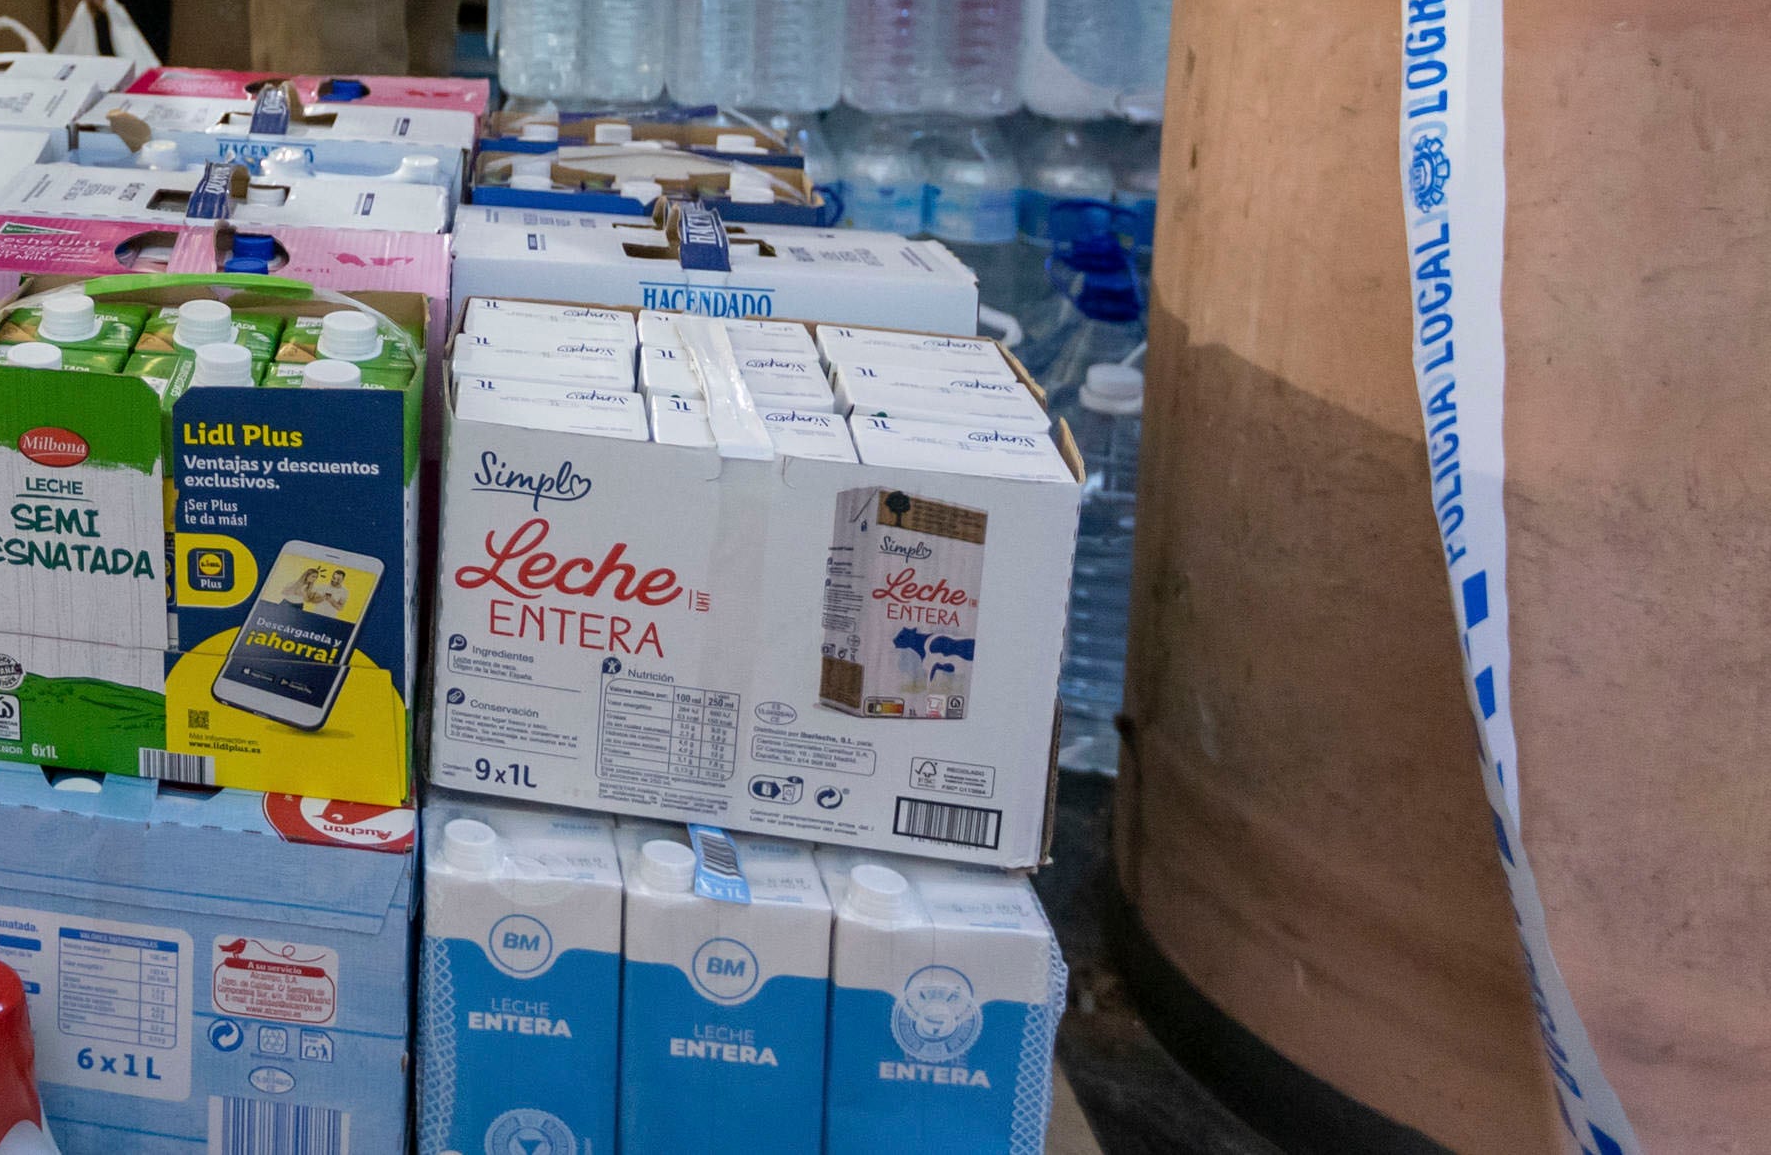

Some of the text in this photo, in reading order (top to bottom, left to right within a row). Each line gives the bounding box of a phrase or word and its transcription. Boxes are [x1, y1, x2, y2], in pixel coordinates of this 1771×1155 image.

[643, 287, 772, 318] HACENDADO
[1414, 223, 1454, 375] LOCAL
[22, 435, 87, 454] Milbona
[184, 422, 303, 448] Lidl Plus
[183, 454, 380, 476] Ventajas y descuentos
[25, 476, 84, 495] LECHE
[184, 472, 280, 490] exclusivos.
[184, 498, 238, 513] ¡Ser Plus
[10, 503, 101, 537] SEMI
[184, 513, 248, 526] te da más!
[455, 518, 711, 613] Leche UHT
[200, 578, 222, 590] Plus
[872, 568, 967, 606] Leche
[887, 603, 960, 627] ENTERA
[256, 616, 343, 648] Descárgatela y
[489, 599, 664, 658] ENTERA
[245, 629, 339, 665] ¡ahorra!
[472, 645, 534, 664] Ingredientes
[627, 669, 675, 683] Nutrición
[470, 698, 539, 718] Conservación
[31, 743, 58, 759] 6x1L
[189, 740, 261, 754] www.lidlplus.es
[323, 823, 394, 841] Auchan
[502, 932, 540, 951] BM
[247, 961, 254, 969] A
[706, 956, 746, 977] BM
[491, 997, 550, 1016] LECHE
[468, 1011, 572, 1038] ENTERA
[694, 1023, 755, 1044] LECHE
[78, 1047, 94, 1071] 6
[99, 1055, 117, 1074] x
[669, 1038, 779, 1067] ENTERA
[879, 1061, 991, 1089] ENTERA
